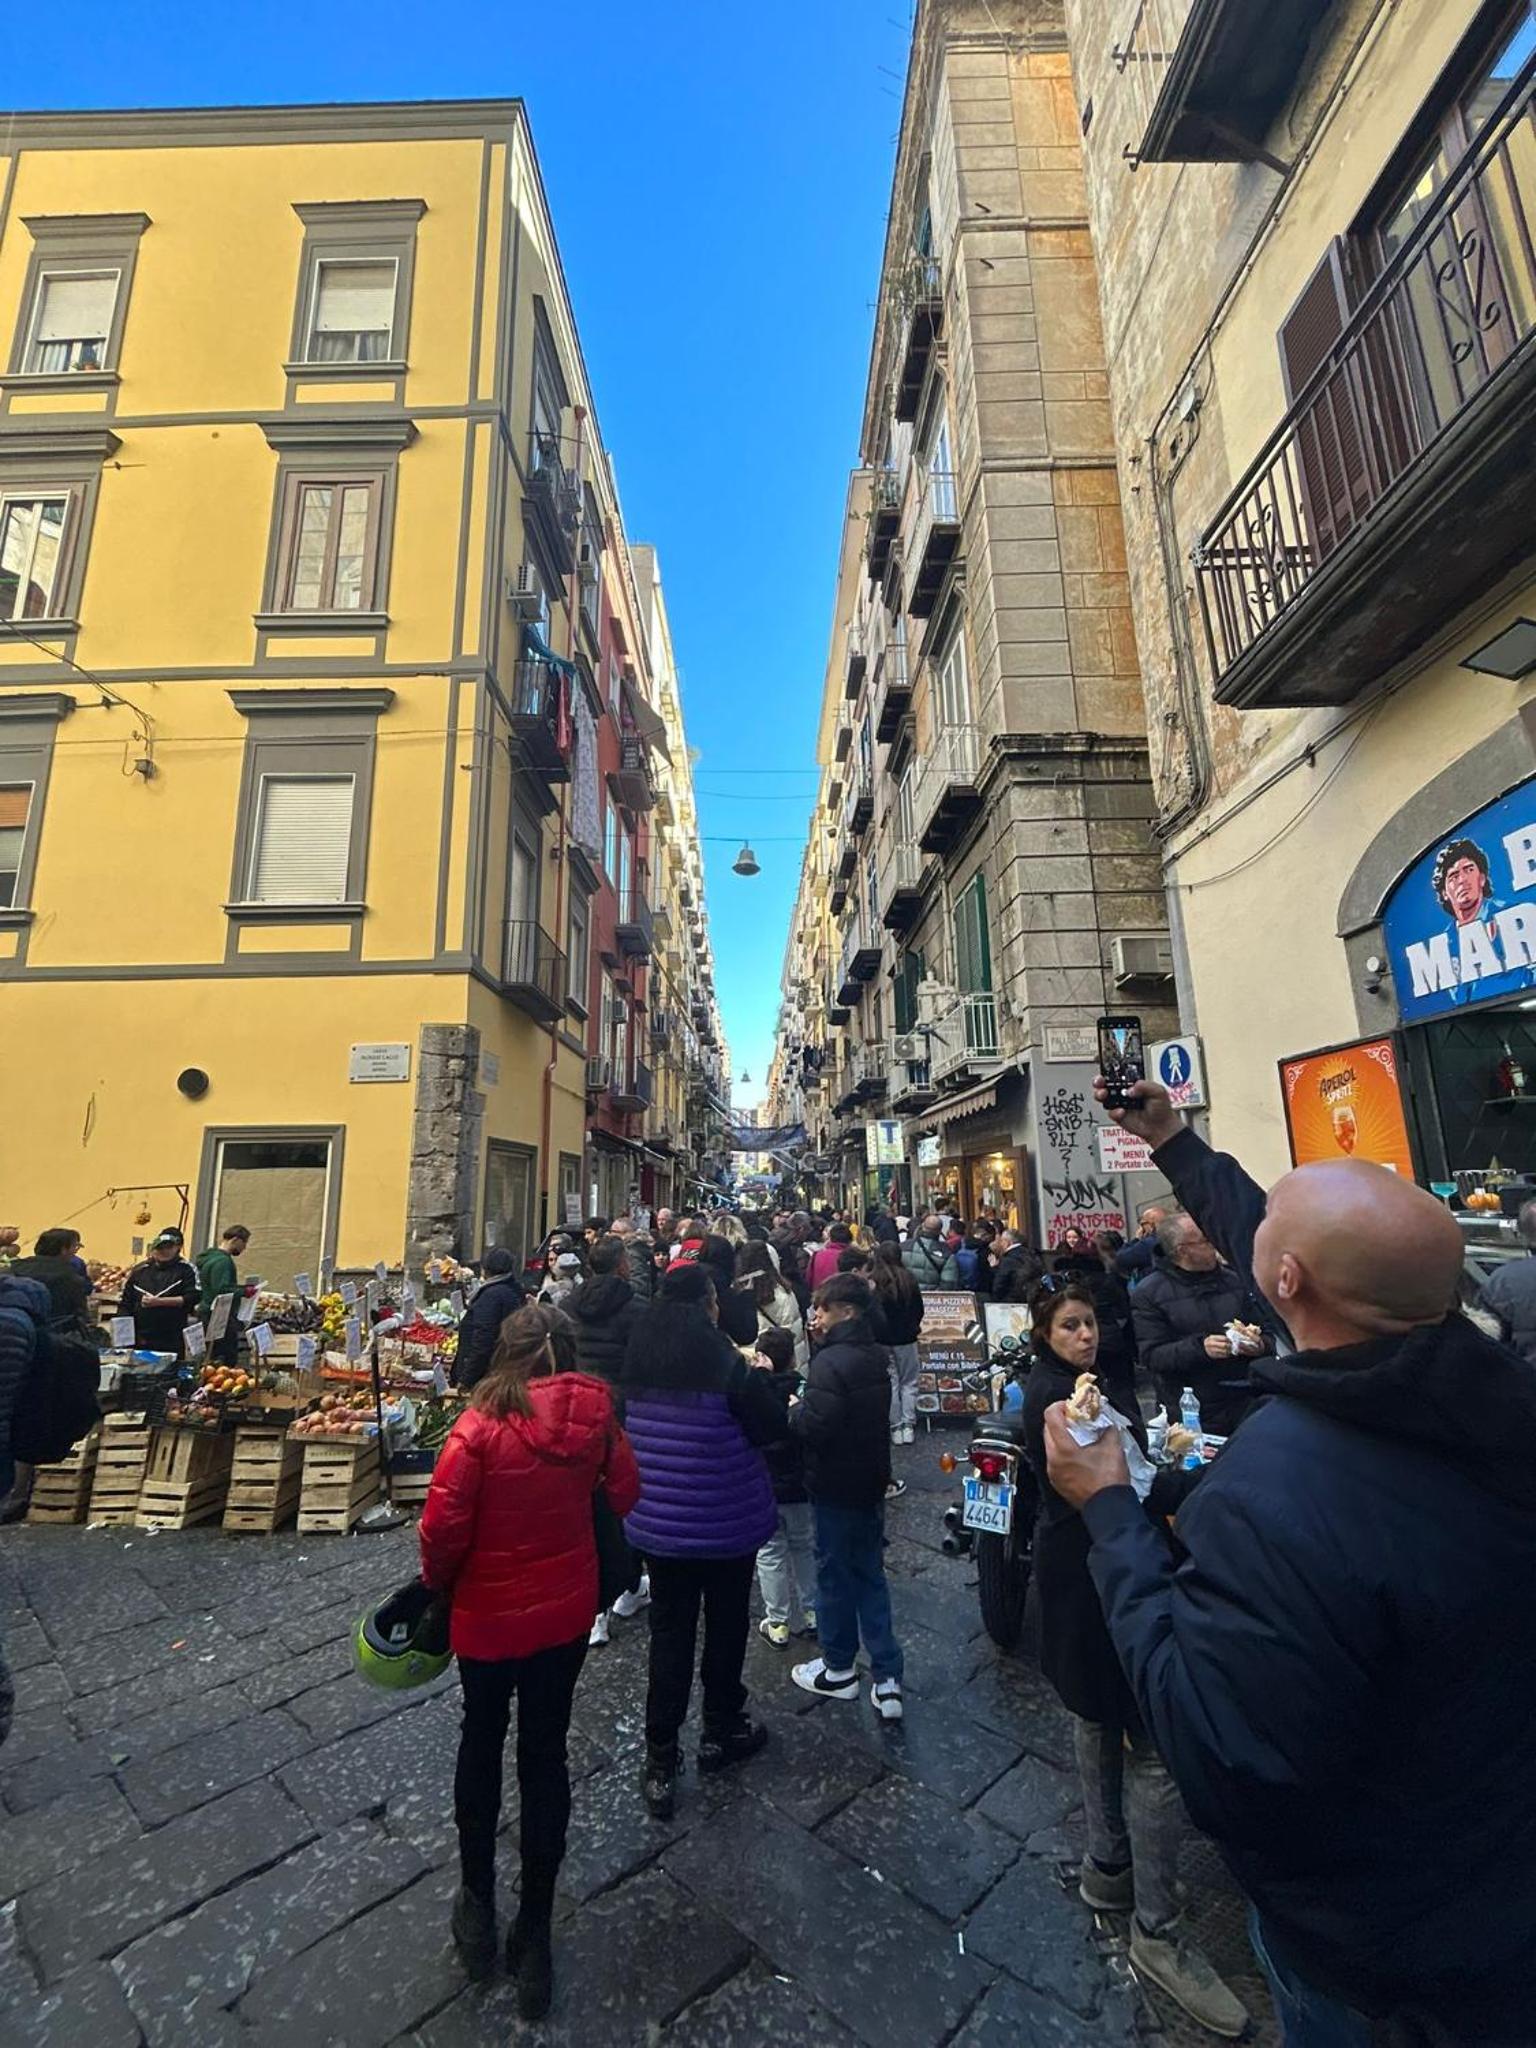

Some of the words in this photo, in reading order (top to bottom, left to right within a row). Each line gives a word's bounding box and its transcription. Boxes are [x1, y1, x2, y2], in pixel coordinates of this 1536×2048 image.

[1320, 1068, 1356, 1098] APEROL
[1327, 1084, 1353, 1105] SPRITZ
[880, 1122, 899, 1144] T
[1107, 1161, 1112, 1169] 2
[967, 1504, 1007, 1528] 44641
